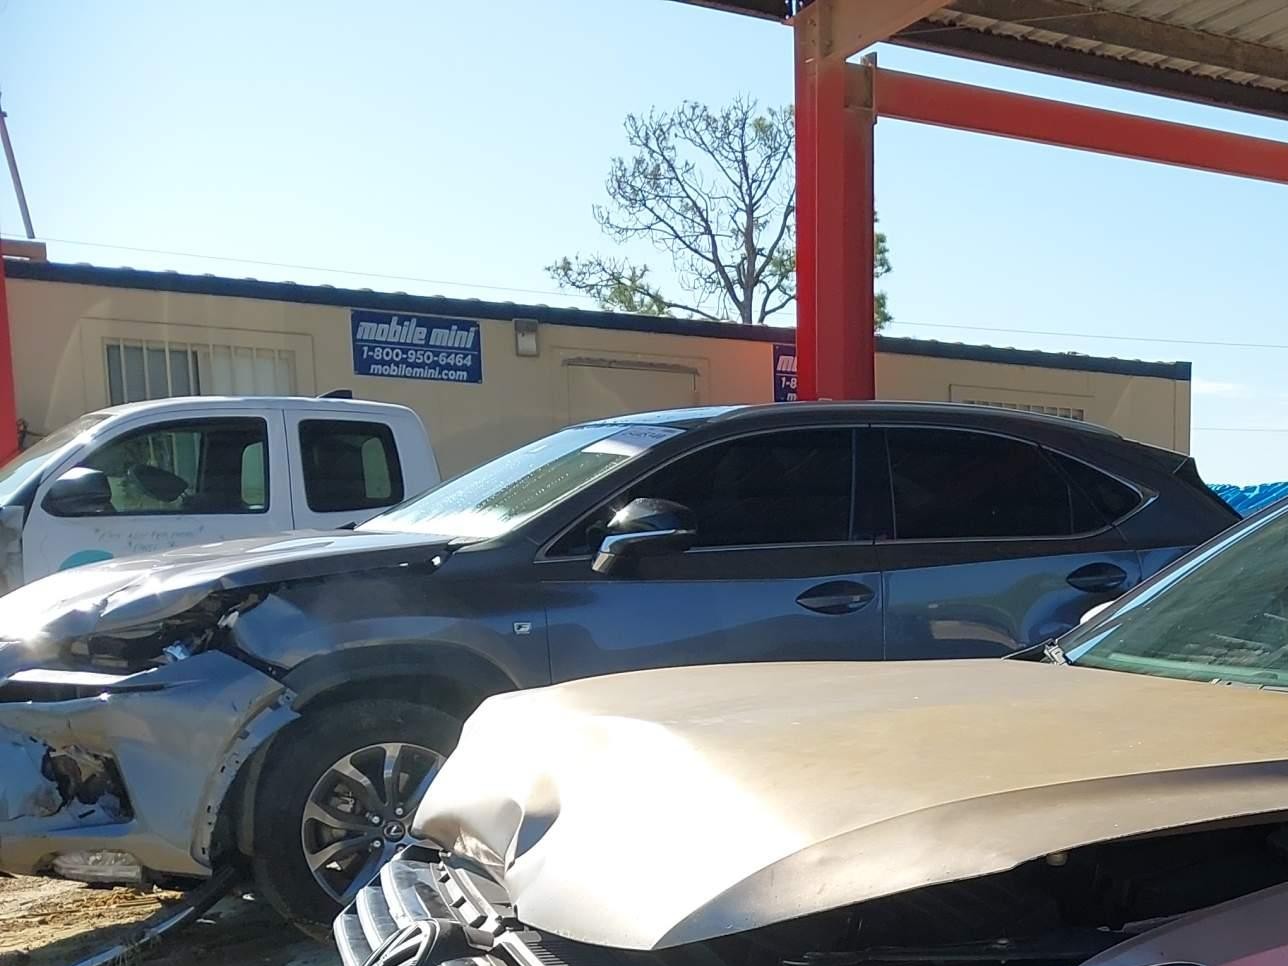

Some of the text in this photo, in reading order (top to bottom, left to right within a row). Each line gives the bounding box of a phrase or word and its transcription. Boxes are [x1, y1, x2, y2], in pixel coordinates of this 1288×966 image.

[356, 316, 475, 348] mobile mini
[362, 346, 472, 367] 1-800-950-6464
[370, 363, 467, 380] mobilemini.com
